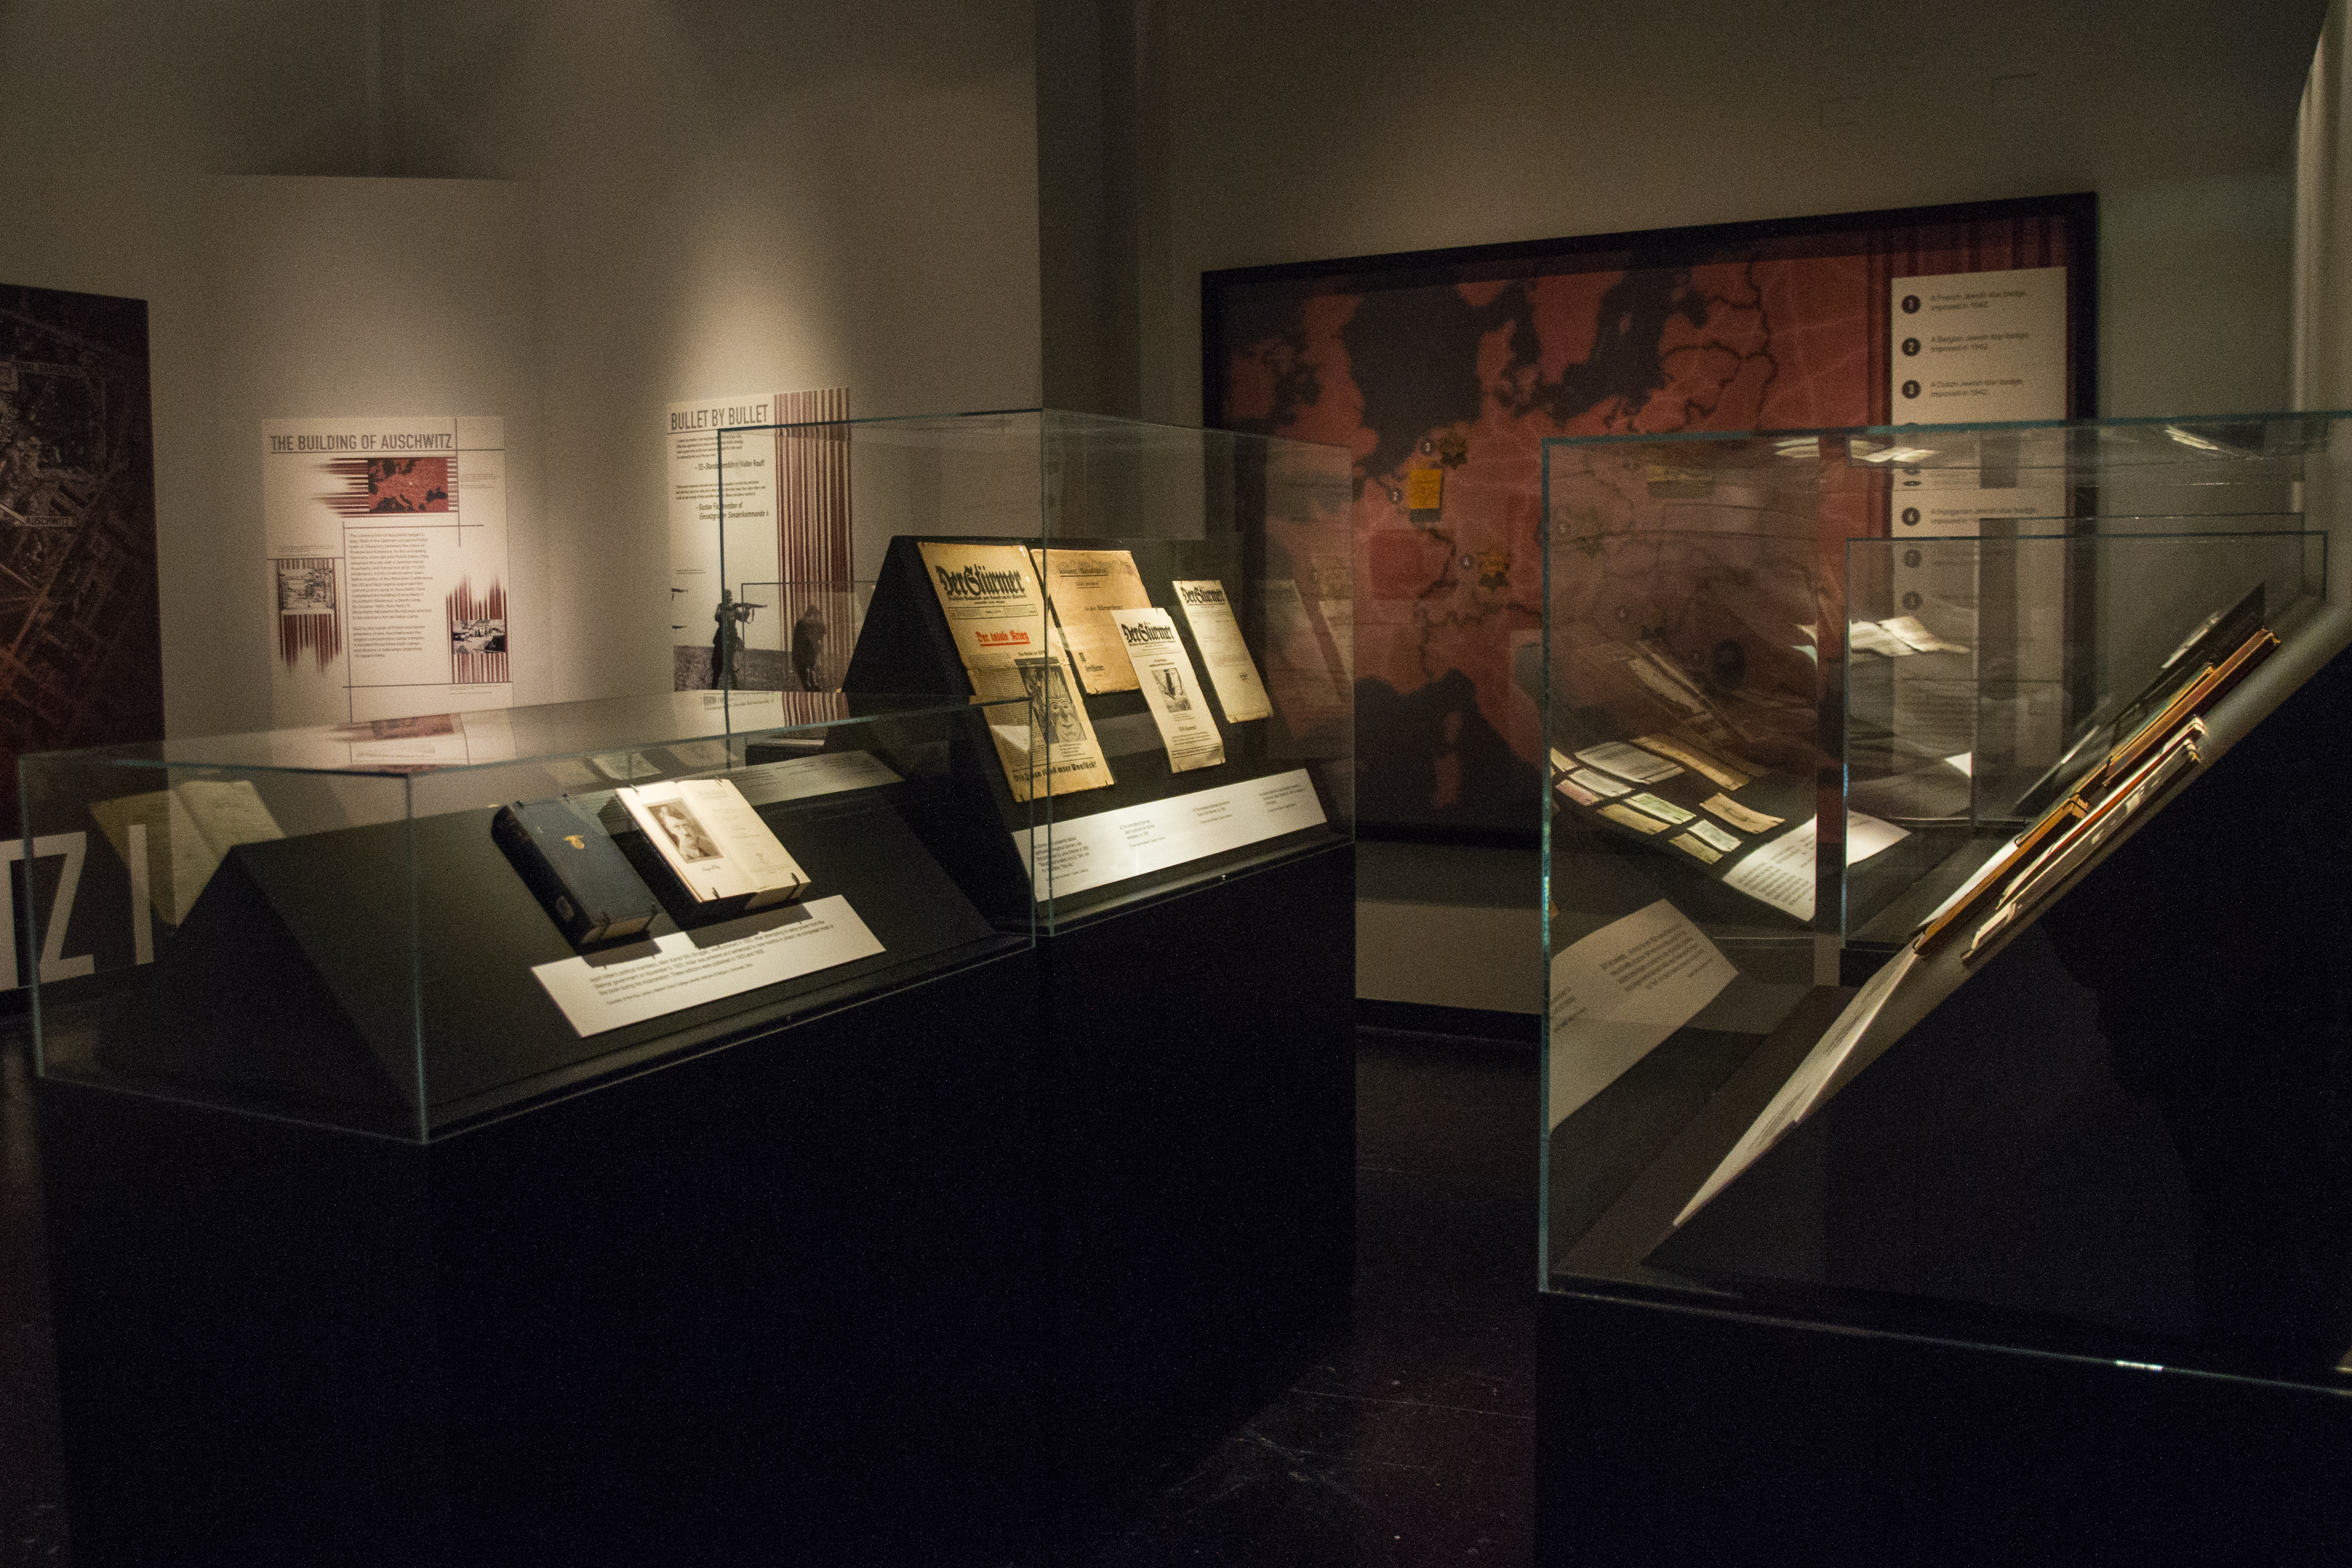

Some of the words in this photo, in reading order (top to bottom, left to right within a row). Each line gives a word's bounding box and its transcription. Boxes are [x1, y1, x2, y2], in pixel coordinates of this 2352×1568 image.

[671, 410, 708, 430] BULLET
[712, 408, 725, 426] BY
[729, 405, 768, 425] BULLET
[270, 435, 293, 451] THE
[298, 435, 357, 450] BUILDING
[361, 434, 377, 450] OF
[381, 433, 452, 449] AUSCHWITZ
